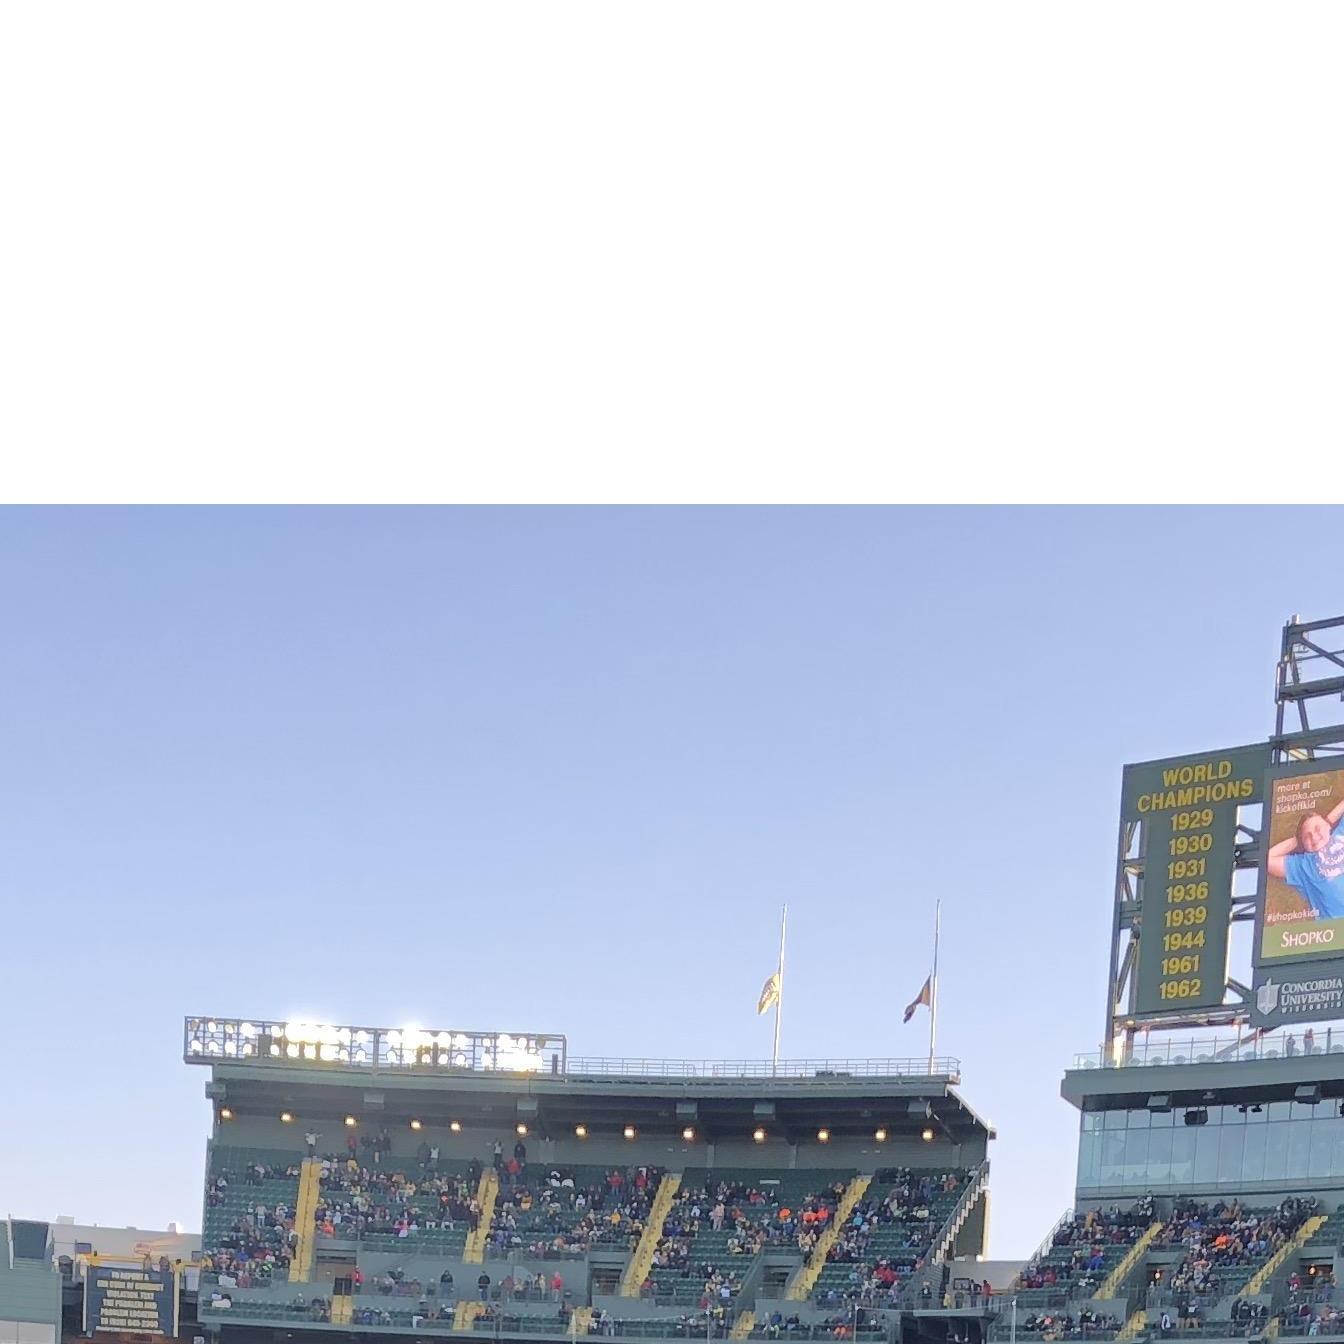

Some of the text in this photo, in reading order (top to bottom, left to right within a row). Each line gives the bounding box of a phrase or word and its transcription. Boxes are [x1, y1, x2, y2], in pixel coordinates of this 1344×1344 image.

[1163, 760, 1232, 787] WORLD
[1137, 779, 1254, 813] CHAMPIONS
[1170, 808, 1213, 832] 1929
[1169, 834, 1213, 855] 1930
[1167, 857, 1206, 880] 1931
[1166, 881, 1208, 903] 1936
[1164, 905, 1207, 928] 1939
[1163, 930, 1205, 952] 1944
[1161, 955, 1199, 976] 1961
[1159, 979, 1201, 1000] 1962
[1281, 978, 1343, 995] CONCORDIA
[1281, 990, 1344, 1006] UNIVERSITY
